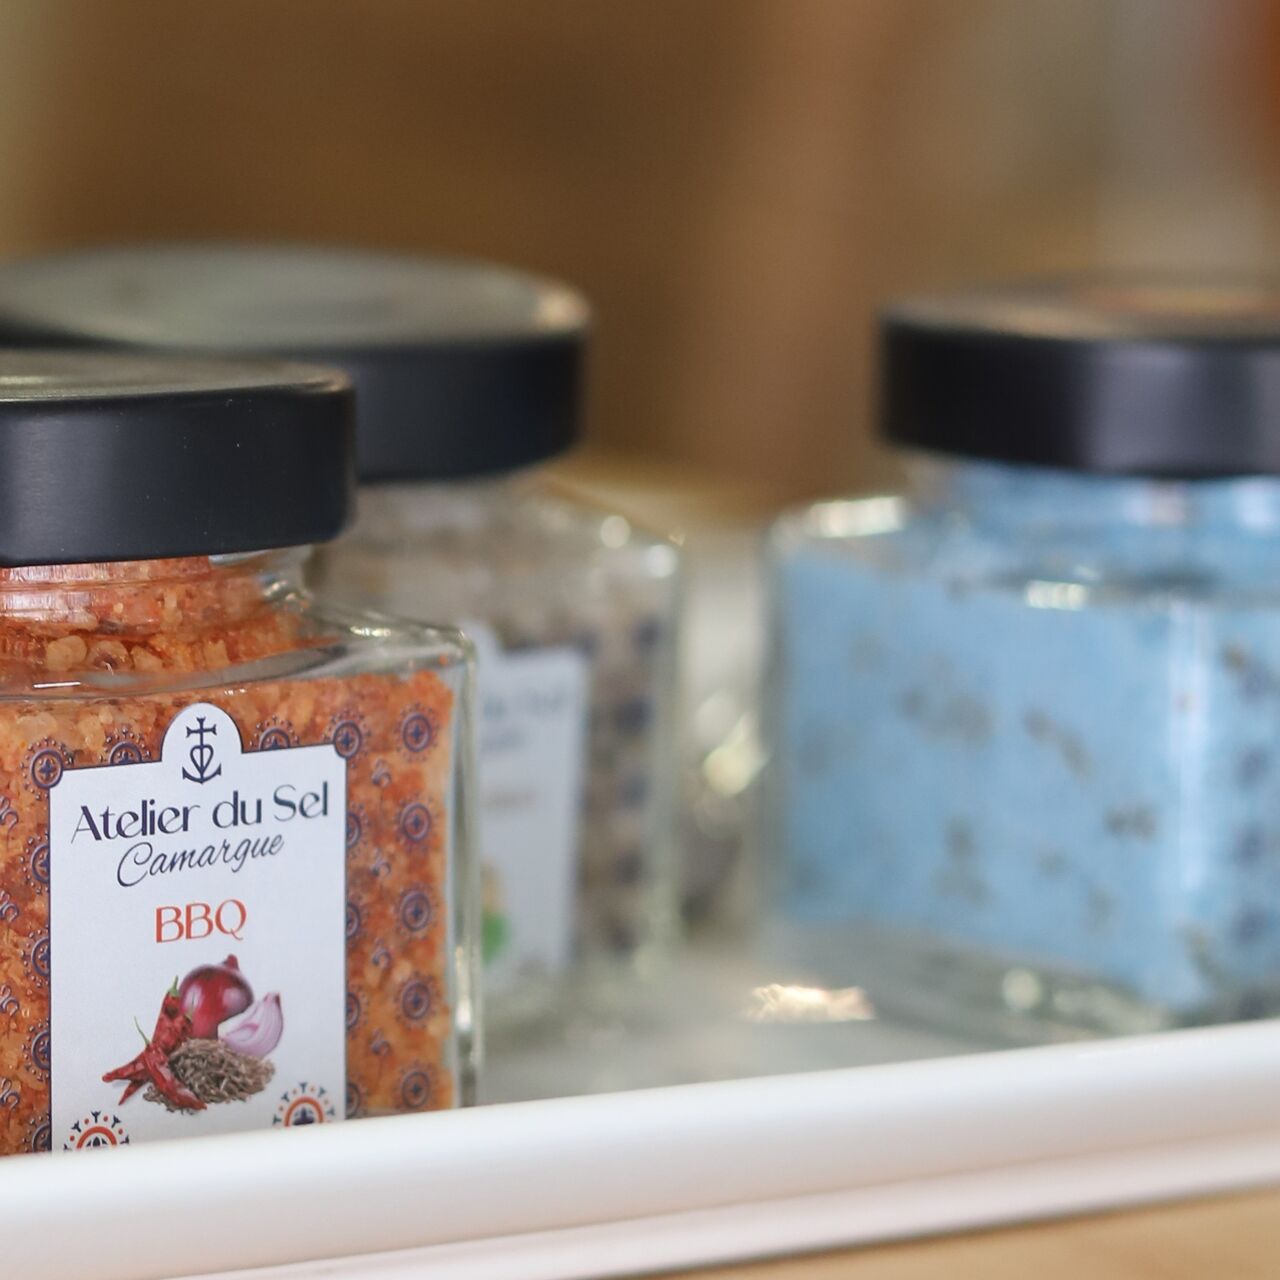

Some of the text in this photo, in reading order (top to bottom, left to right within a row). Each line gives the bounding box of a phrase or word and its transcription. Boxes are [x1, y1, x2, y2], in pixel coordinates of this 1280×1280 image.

[71, 781, 329, 843] Atelier du Sel
[117, 831, 284, 887] Camargue
[155, 899, 247, 943] BBQ
